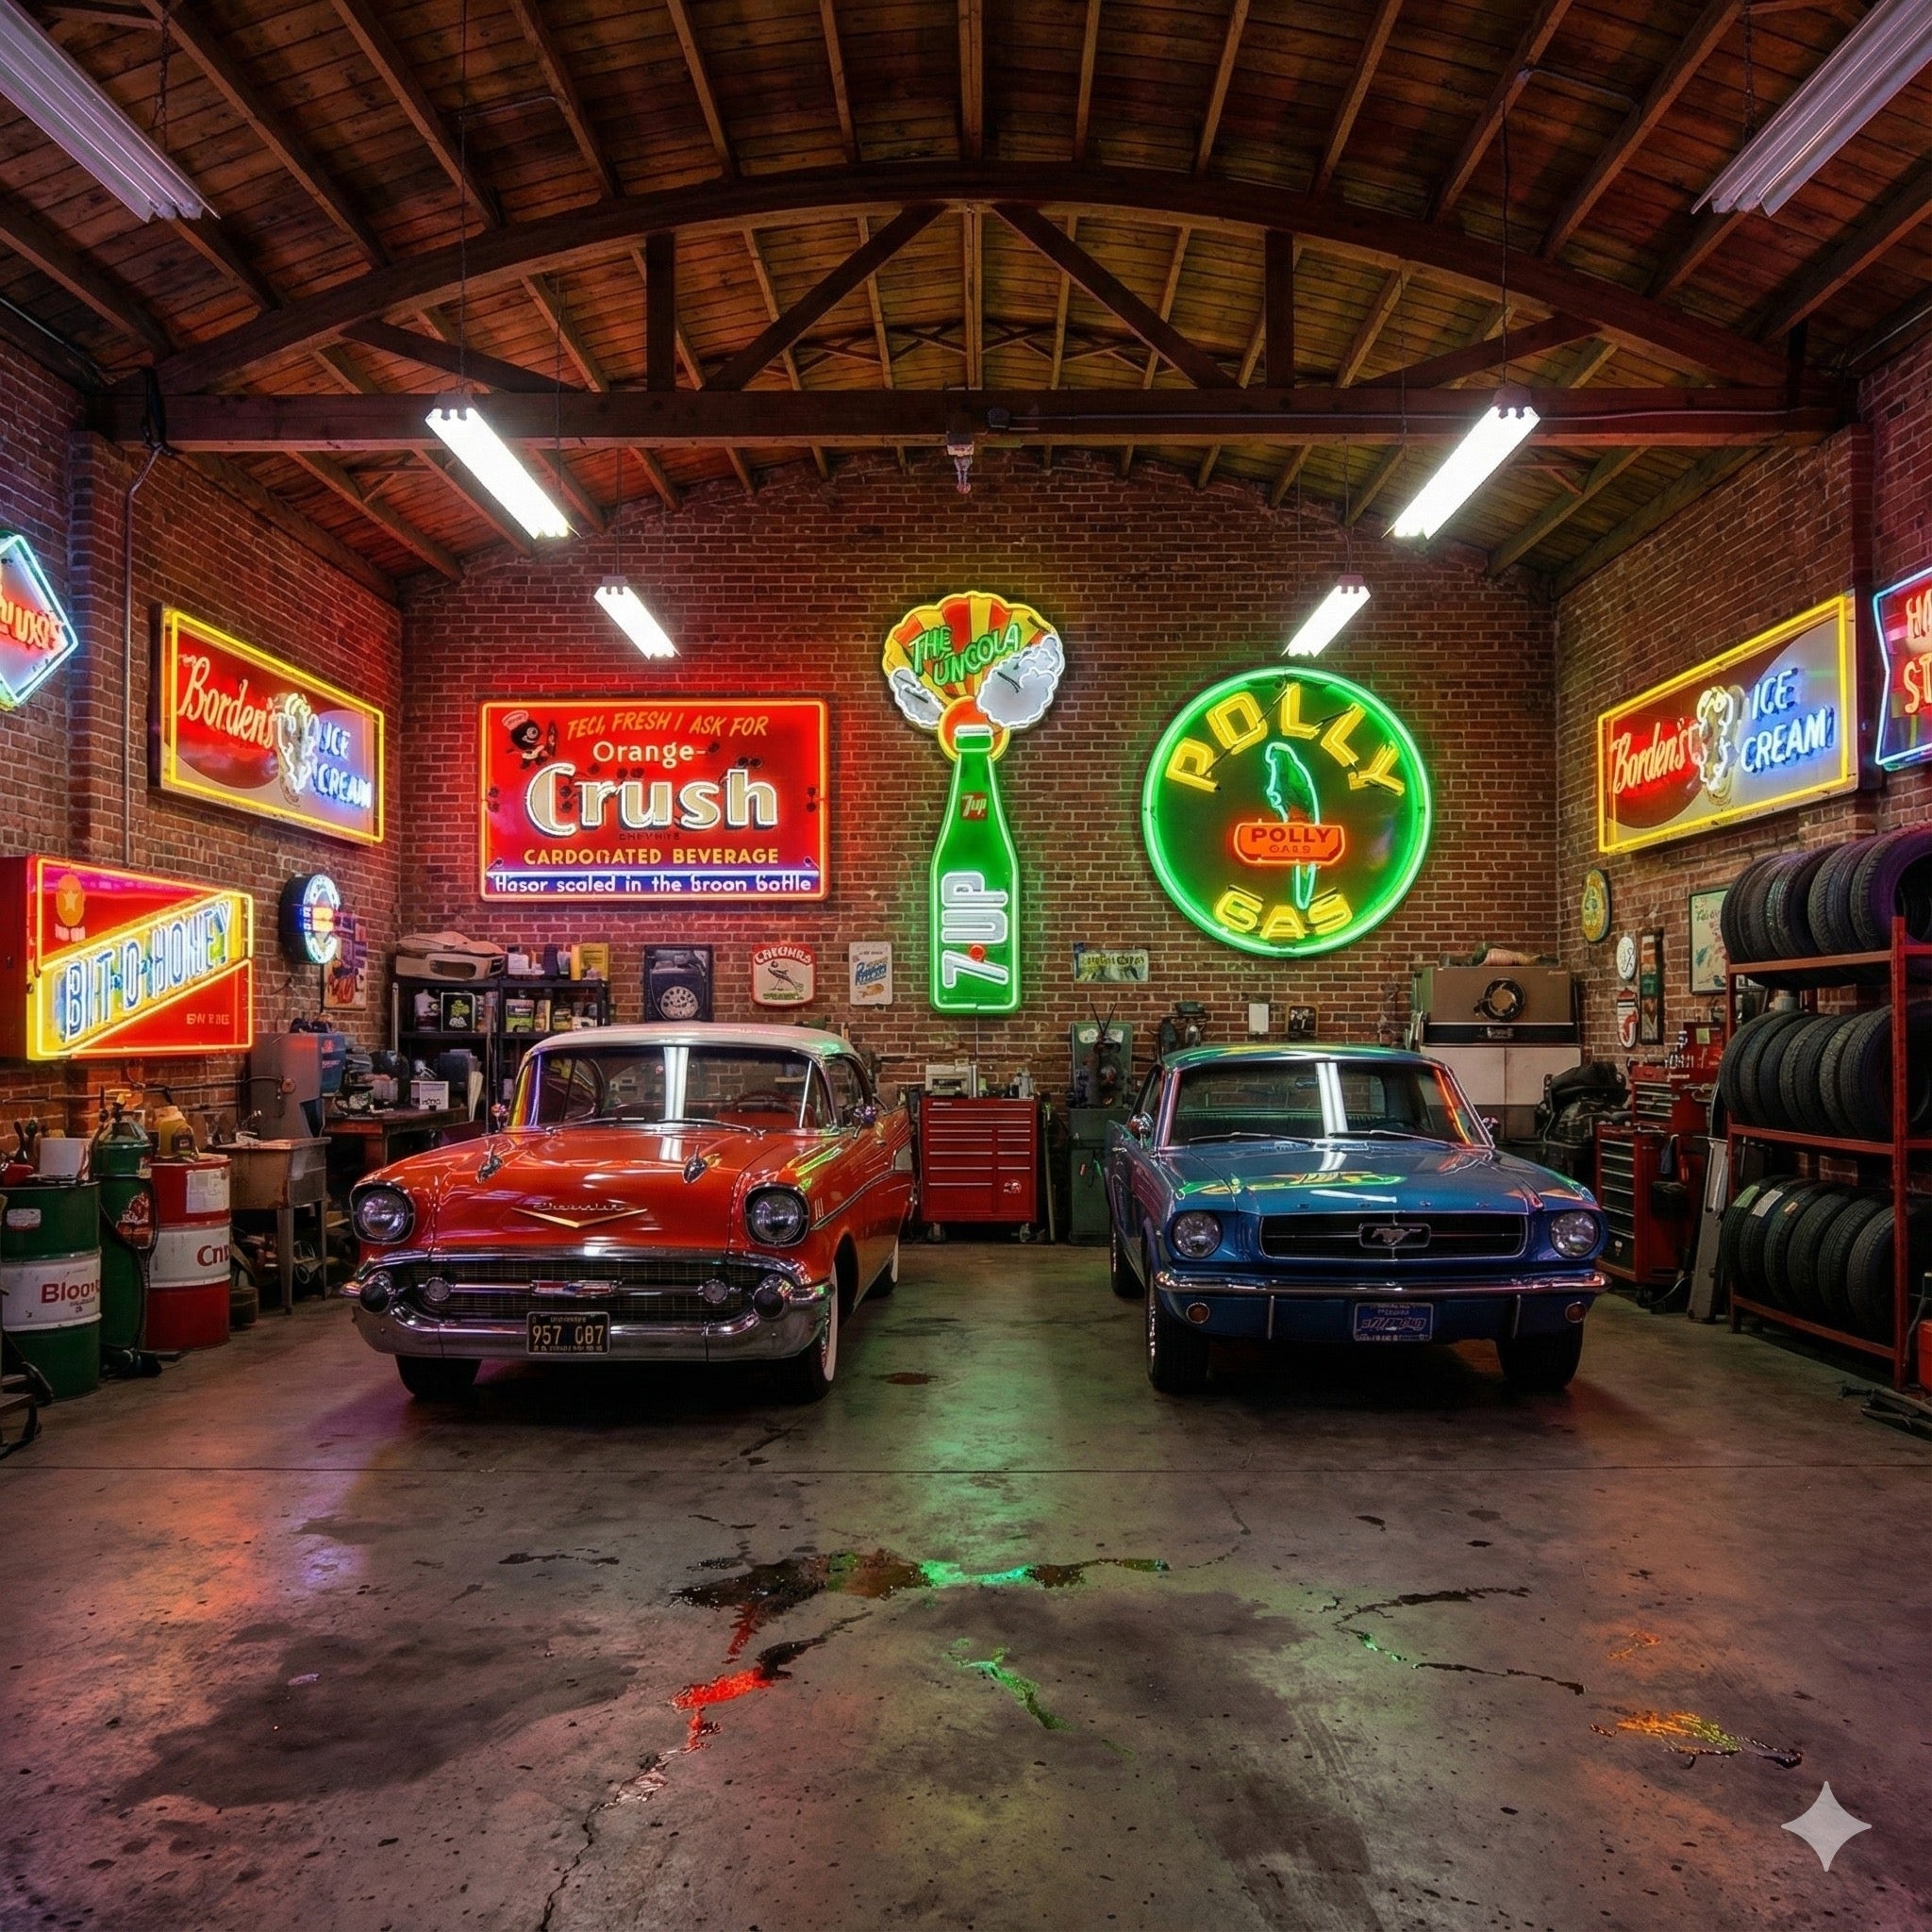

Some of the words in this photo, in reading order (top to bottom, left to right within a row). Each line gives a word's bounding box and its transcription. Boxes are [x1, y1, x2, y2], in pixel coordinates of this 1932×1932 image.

[908, 626, 952, 676] THE
[933, 624, 1022, 686] UNCOLA
[176, 655, 276, 749] Borden's
[1752, 669, 1795, 720] ICE
[319, 721, 352, 758] ICE
[611, 711, 672, 732] FRESH
[689, 716, 726, 736] ASK
[728, 716, 769, 737] FOR
[1165, 683, 1405, 796] POLLY
[1740, 708, 1828, 773] CREAM
[1609, 718, 1689, 794] Borden's
[313, 760, 373, 808] CREAM
[525, 762, 780, 838] Crush
[673, 848, 778, 864] BEVERAGE
[1251, 827, 1332, 842] POLLY
[625, 874, 641, 892] in
[651, 874, 682, 892] the
[1213, 888, 1354, 940] GAS
[532, 1324, 561, 1345] 957
